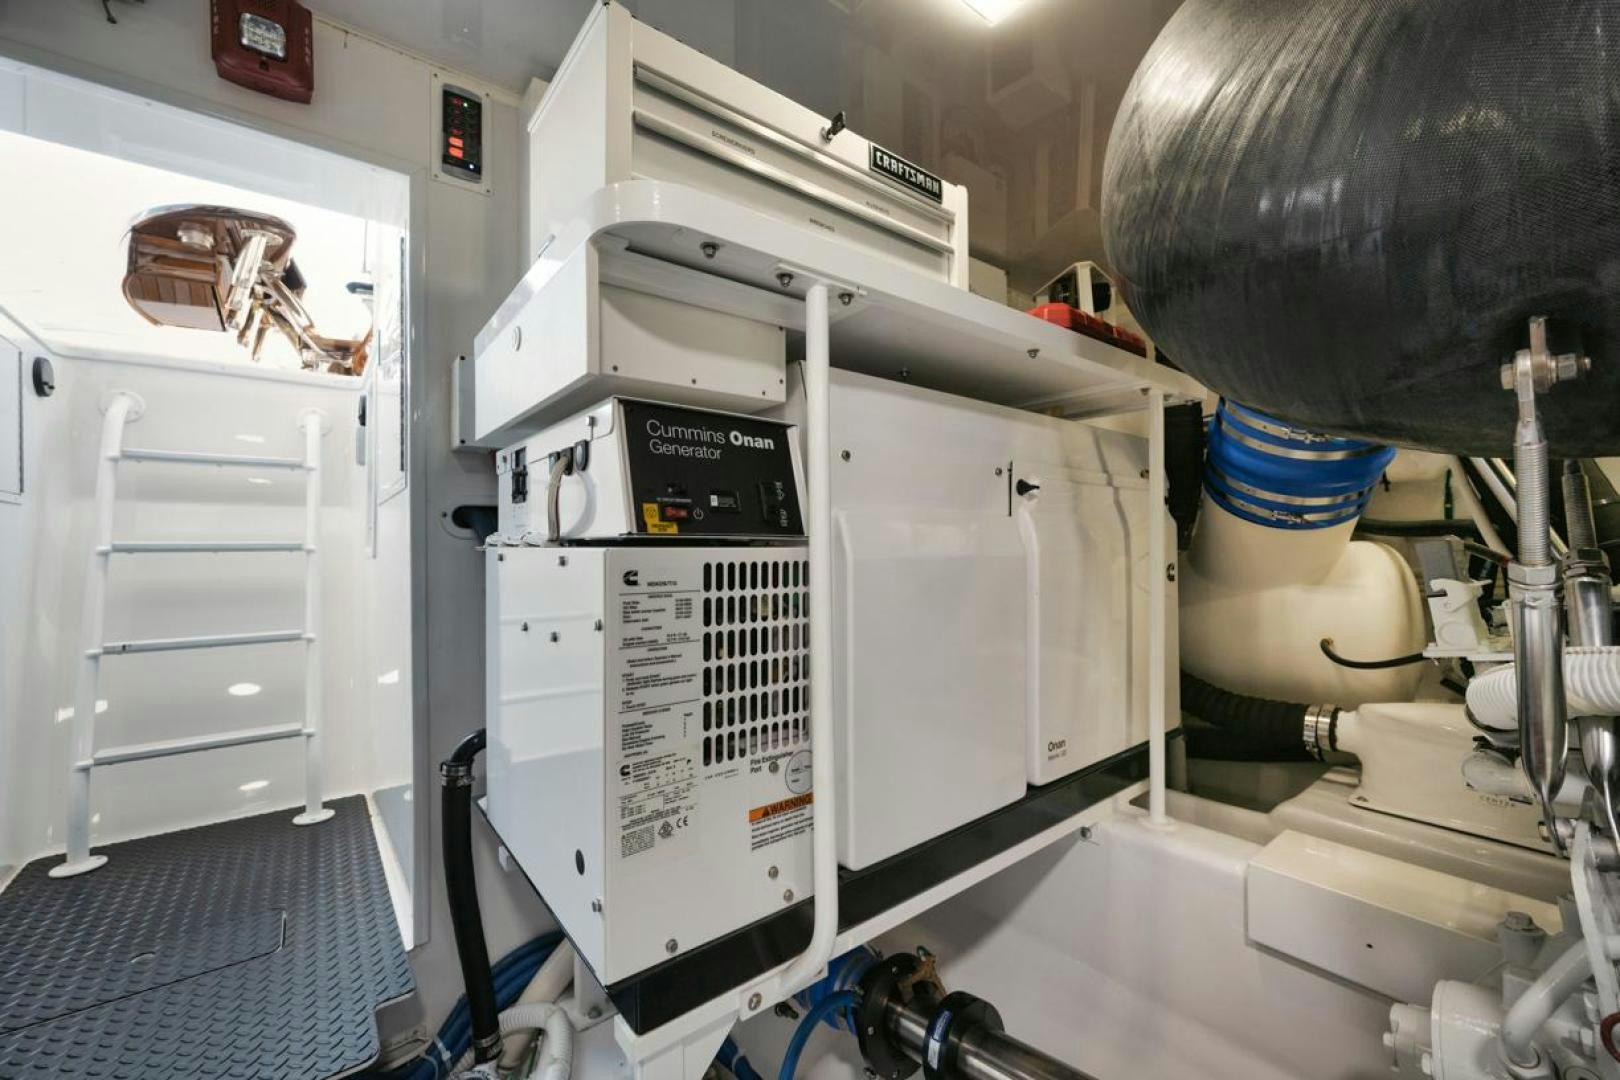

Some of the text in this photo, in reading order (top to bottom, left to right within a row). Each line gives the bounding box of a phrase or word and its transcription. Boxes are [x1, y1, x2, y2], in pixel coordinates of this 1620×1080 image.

[875, 150, 940, 195] CRAFTSMAN
[646, 419, 775, 450] Cummins Onan
[649, 438, 722, 460] Generator
[1047, 739, 1066, 752] Onan
